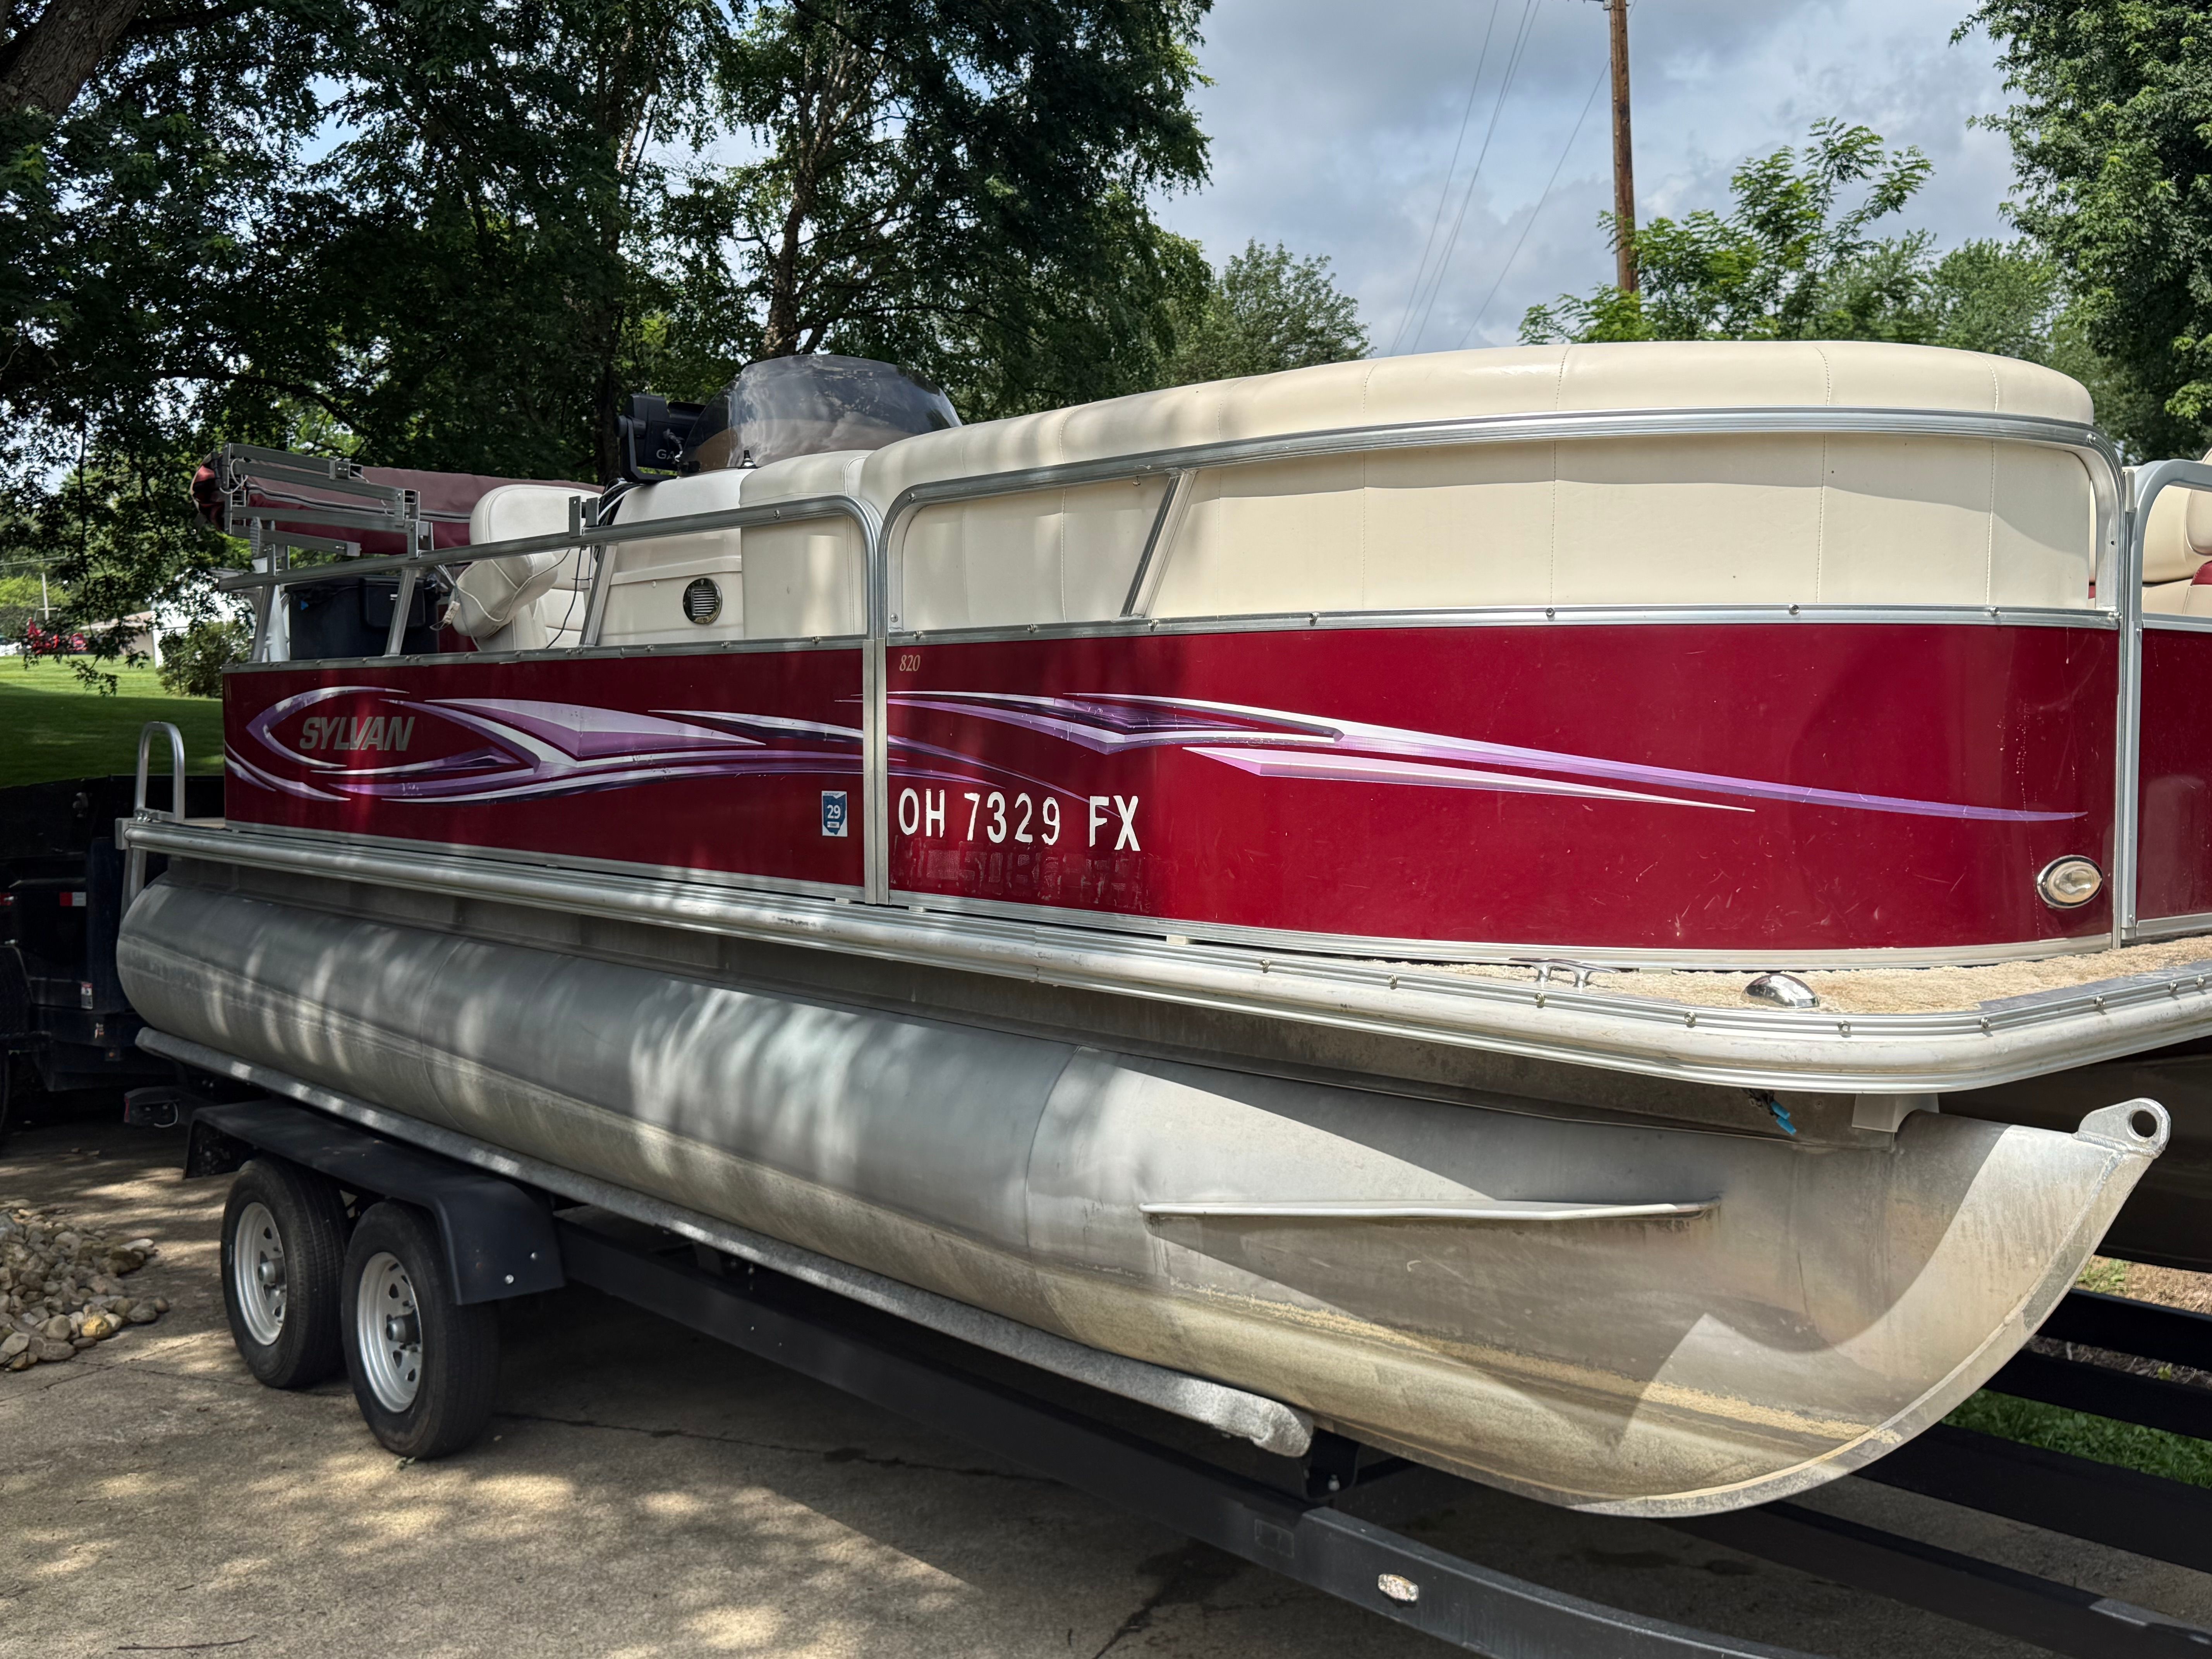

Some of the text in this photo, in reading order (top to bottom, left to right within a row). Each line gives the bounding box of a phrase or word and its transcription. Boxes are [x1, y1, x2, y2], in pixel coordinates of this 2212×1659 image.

[899, 654, 921, 671] 820
[299, 716, 416, 751] SYLVAN
[827, 804, 841, 819] 29
[898, 787, 1141, 851] OH 7329 FX
